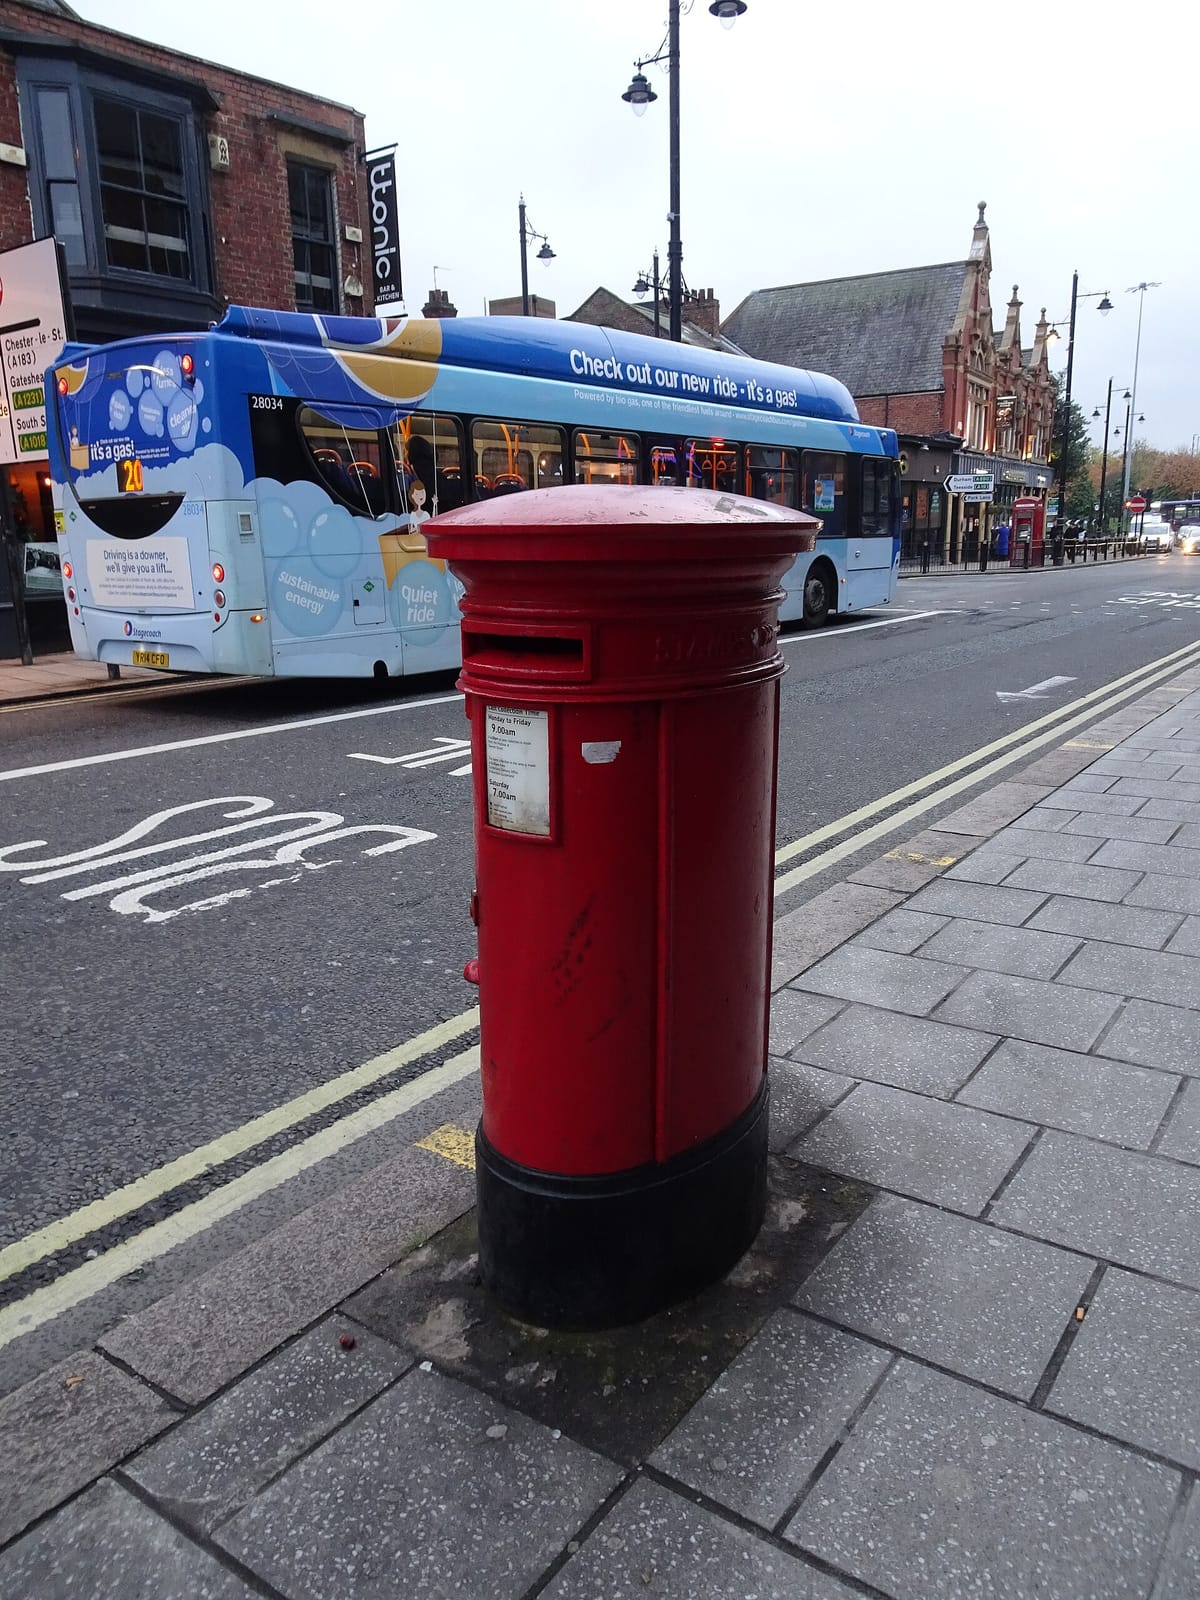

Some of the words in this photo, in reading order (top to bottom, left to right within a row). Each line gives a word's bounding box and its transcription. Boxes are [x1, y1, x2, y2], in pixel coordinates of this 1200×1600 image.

[379, 285, 390, 293] BAR
[377, 292, 400, 302] KITCHEN
[7, 349, 37, 370] (A183)
[10, 372, 45, 388] Gateshea
[570, 349, 623, 380] Check
[626, 362, 653, 385] out
[655, 368, 679, 389] our
[681, 373, 709, 394] new
[713, 374, 738, 398] ride
[746, 378, 763, 402] it's
[766, 387, 773, 404] a
[775, 389, 798, 408] gas!
[13, 389, 44, 409] (A1231)
[251, 395, 283, 410] 28034
[574, 389, 605, 402] Powered
[606, 394, 615, 405] by
[16, 416, 39, 430] South
[20, 433, 47, 452] (A1018
[90, 440, 104, 461] it's
[105, 446, 112, 460] a
[113, 440, 135, 462] gas!
[123, 460, 143, 491] 20
[183, 502, 205, 517] 28034
[103, 549, 127, 561] Driving
[127, 550, 134, 560] is
[139, 550, 169, 561] downer,
[105, 561, 120, 573] we'll
[121, 563, 136, 575] give
[136, 564, 151, 575] you
[278, 570, 340, 603] sustainable
[401, 584, 438, 604] quiet
[285, 590, 324, 616] energy
[407, 606, 435, 622] ride
[133, 628, 162, 639] Stagecoach
[491, 723, 516, 736] 9.00am
[513, 717, 532, 727] Friday
[489, 778, 510, 790] Saturday
[492, 787, 517, 801] 7.00am
